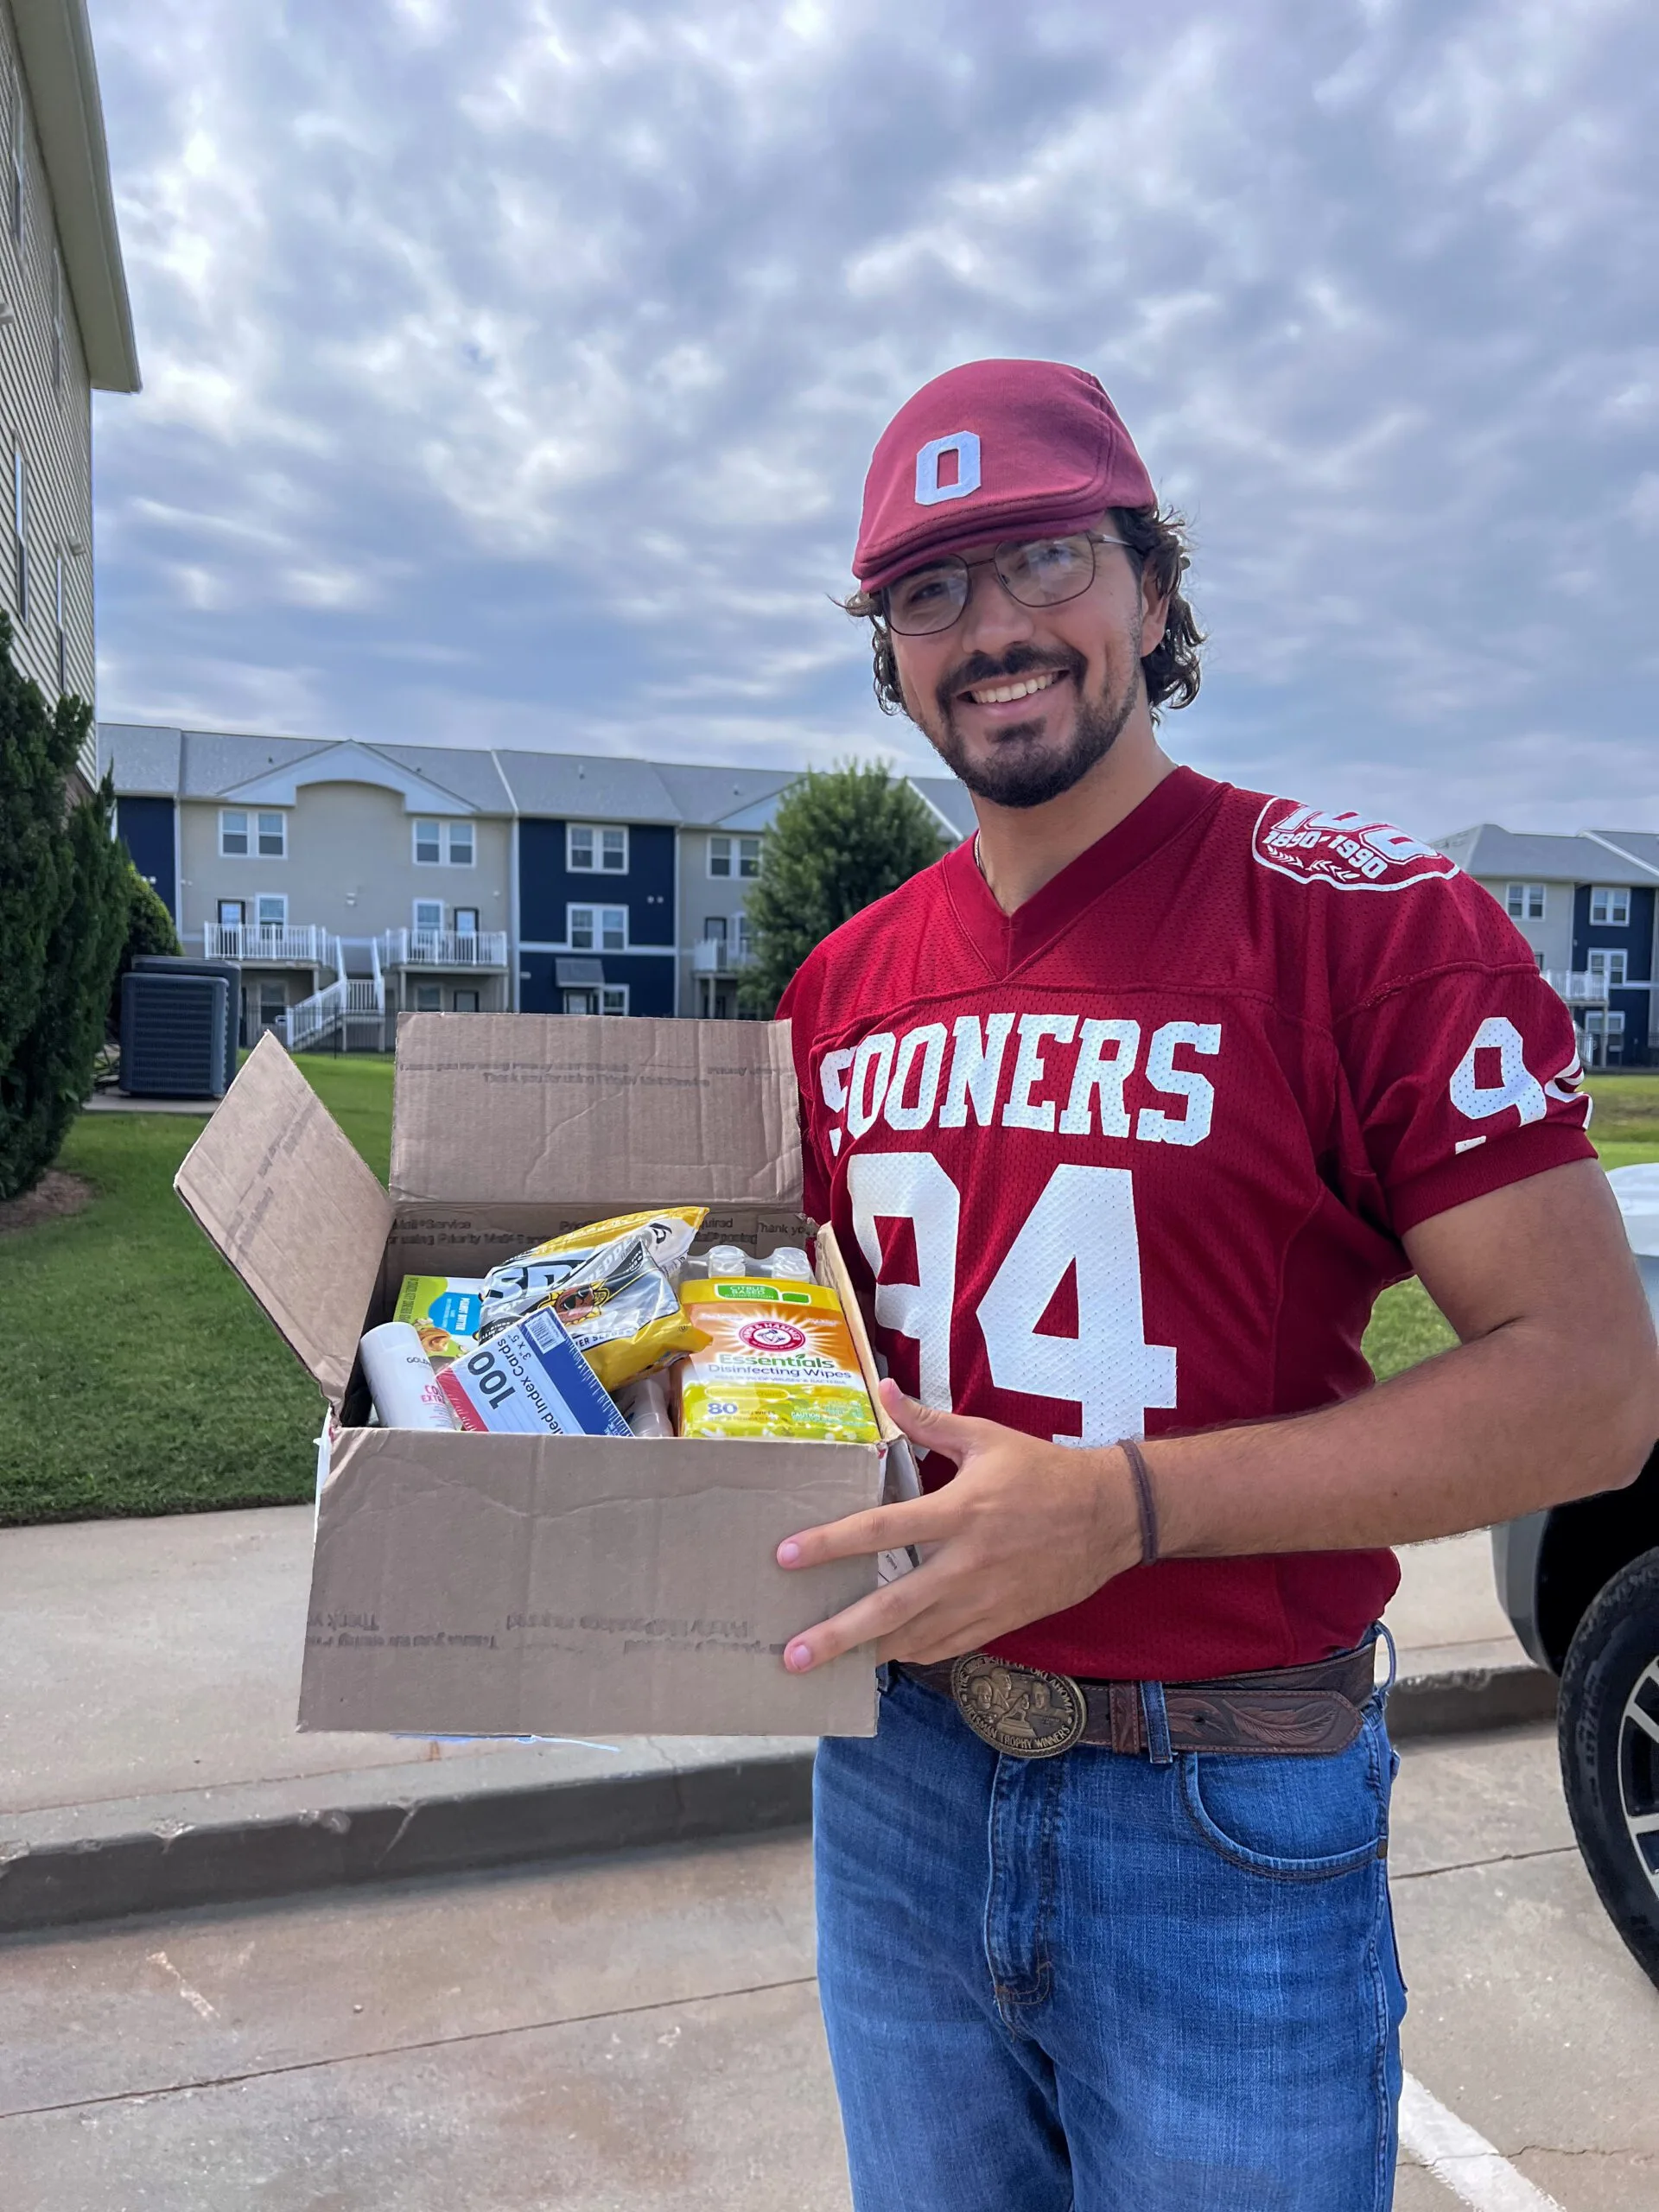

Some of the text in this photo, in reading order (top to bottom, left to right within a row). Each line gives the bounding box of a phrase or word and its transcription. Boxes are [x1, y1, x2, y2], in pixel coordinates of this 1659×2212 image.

[915, 430, 982, 505] O
[1262, 830, 1388, 879] 1890-1990
[819, 1012, 1222, 1156] SOONERS
[847, 1152, 1178, 1450] 94
[467, 1351, 516, 1410] 100
[498, 1338, 563, 1435] led Index Cards
[709, 1364, 852, 1379] Disinfecting Wipes
[719, 1354, 836, 1369] Essentials
[708, 1402, 738, 1414] 80
[1034, 1723, 1071, 1749] WINNERS
